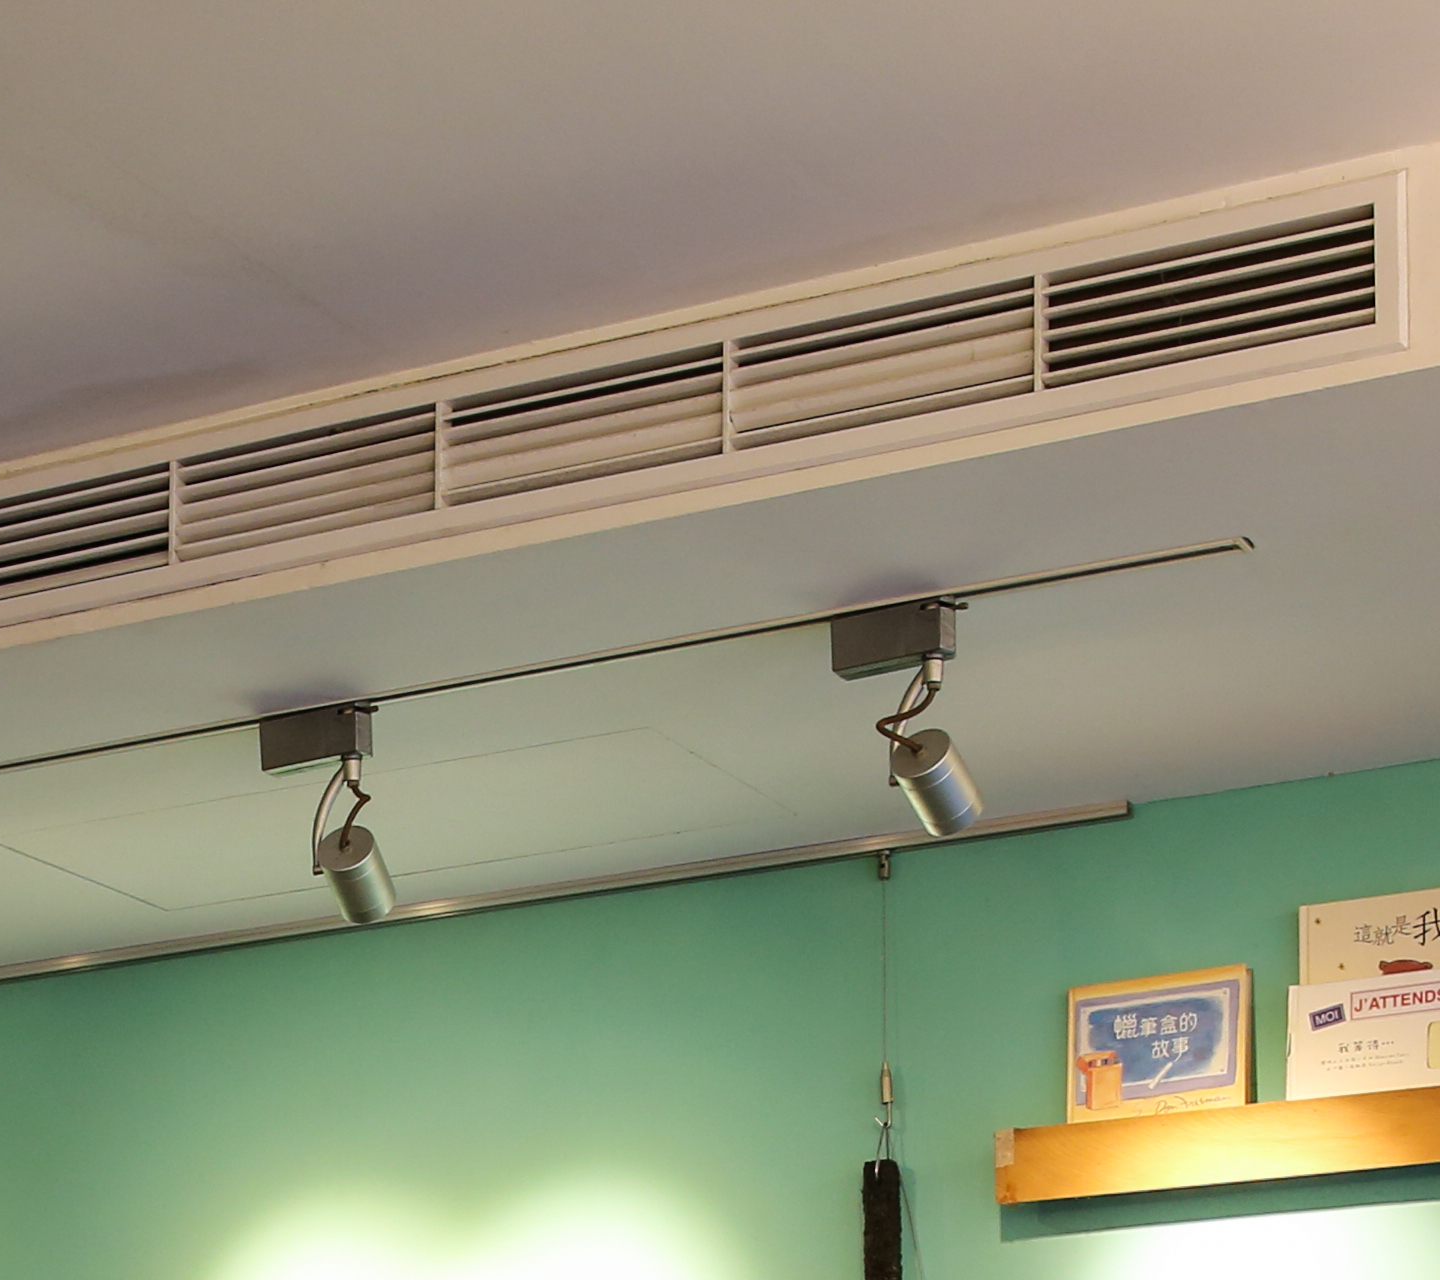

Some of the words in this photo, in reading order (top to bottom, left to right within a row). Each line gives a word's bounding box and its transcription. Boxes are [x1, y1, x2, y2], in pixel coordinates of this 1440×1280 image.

[1113, 1012, 1197, 1040] 蠟筆盒的
[1314, 1010, 1340, 1026] MOI
[1151, 1036, 1190, 1062] 故事
